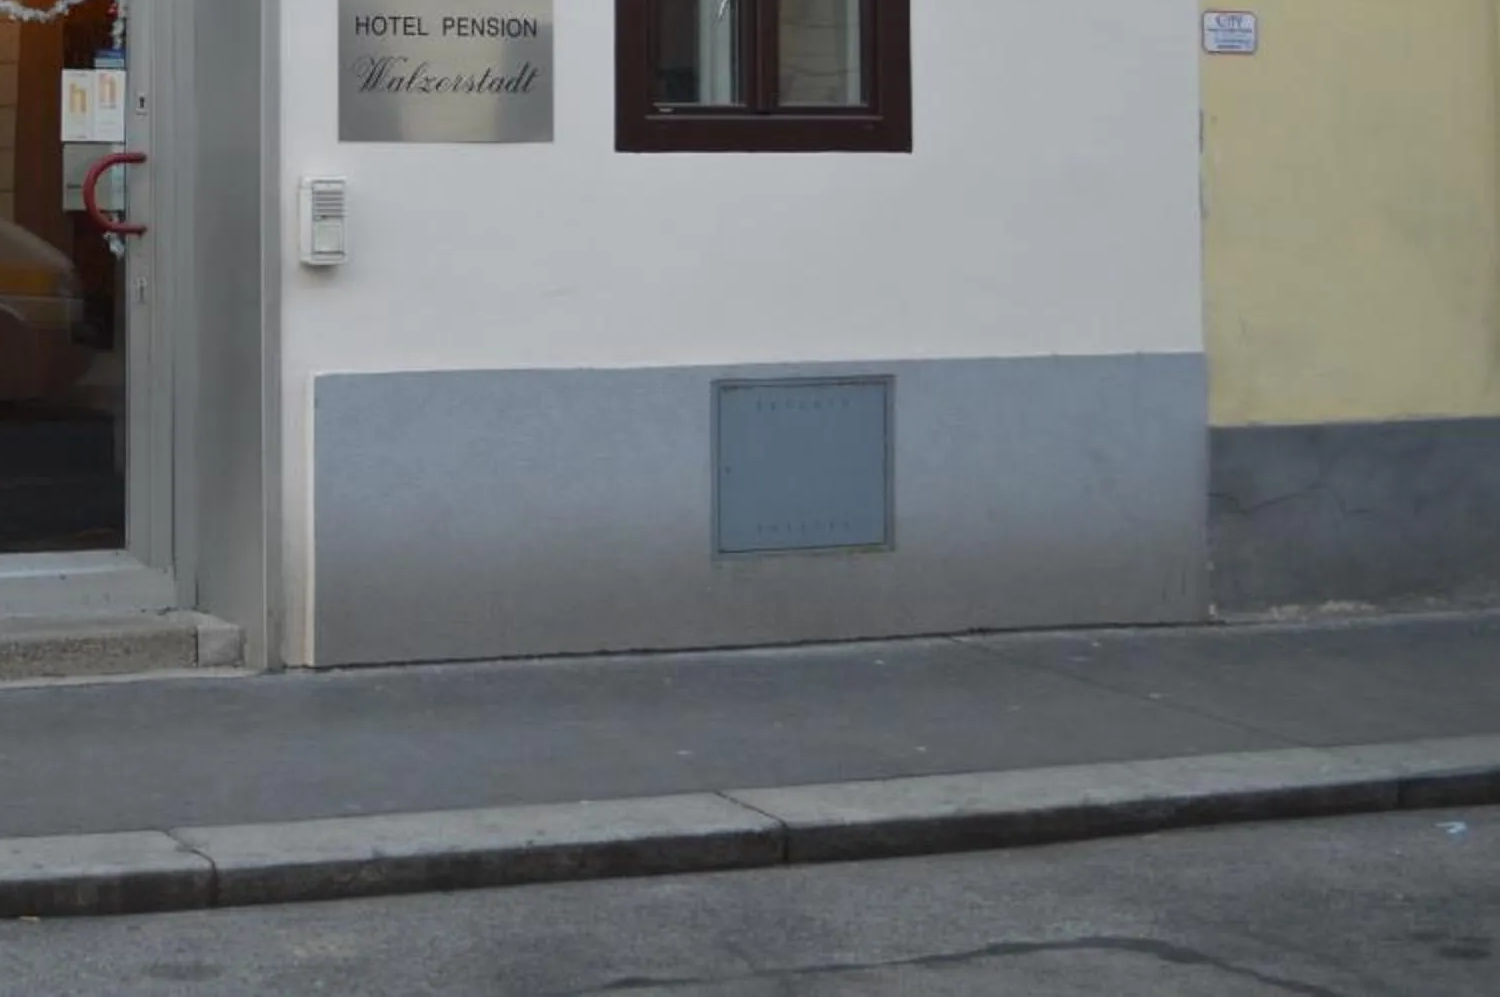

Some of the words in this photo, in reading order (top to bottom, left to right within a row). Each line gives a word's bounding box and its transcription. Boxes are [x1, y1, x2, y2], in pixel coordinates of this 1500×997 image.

[355, 16, 429, 36] HOTEL
[443, 17, 538, 38] PENSION
[351, 55, 540, 94] Walzerstadt
